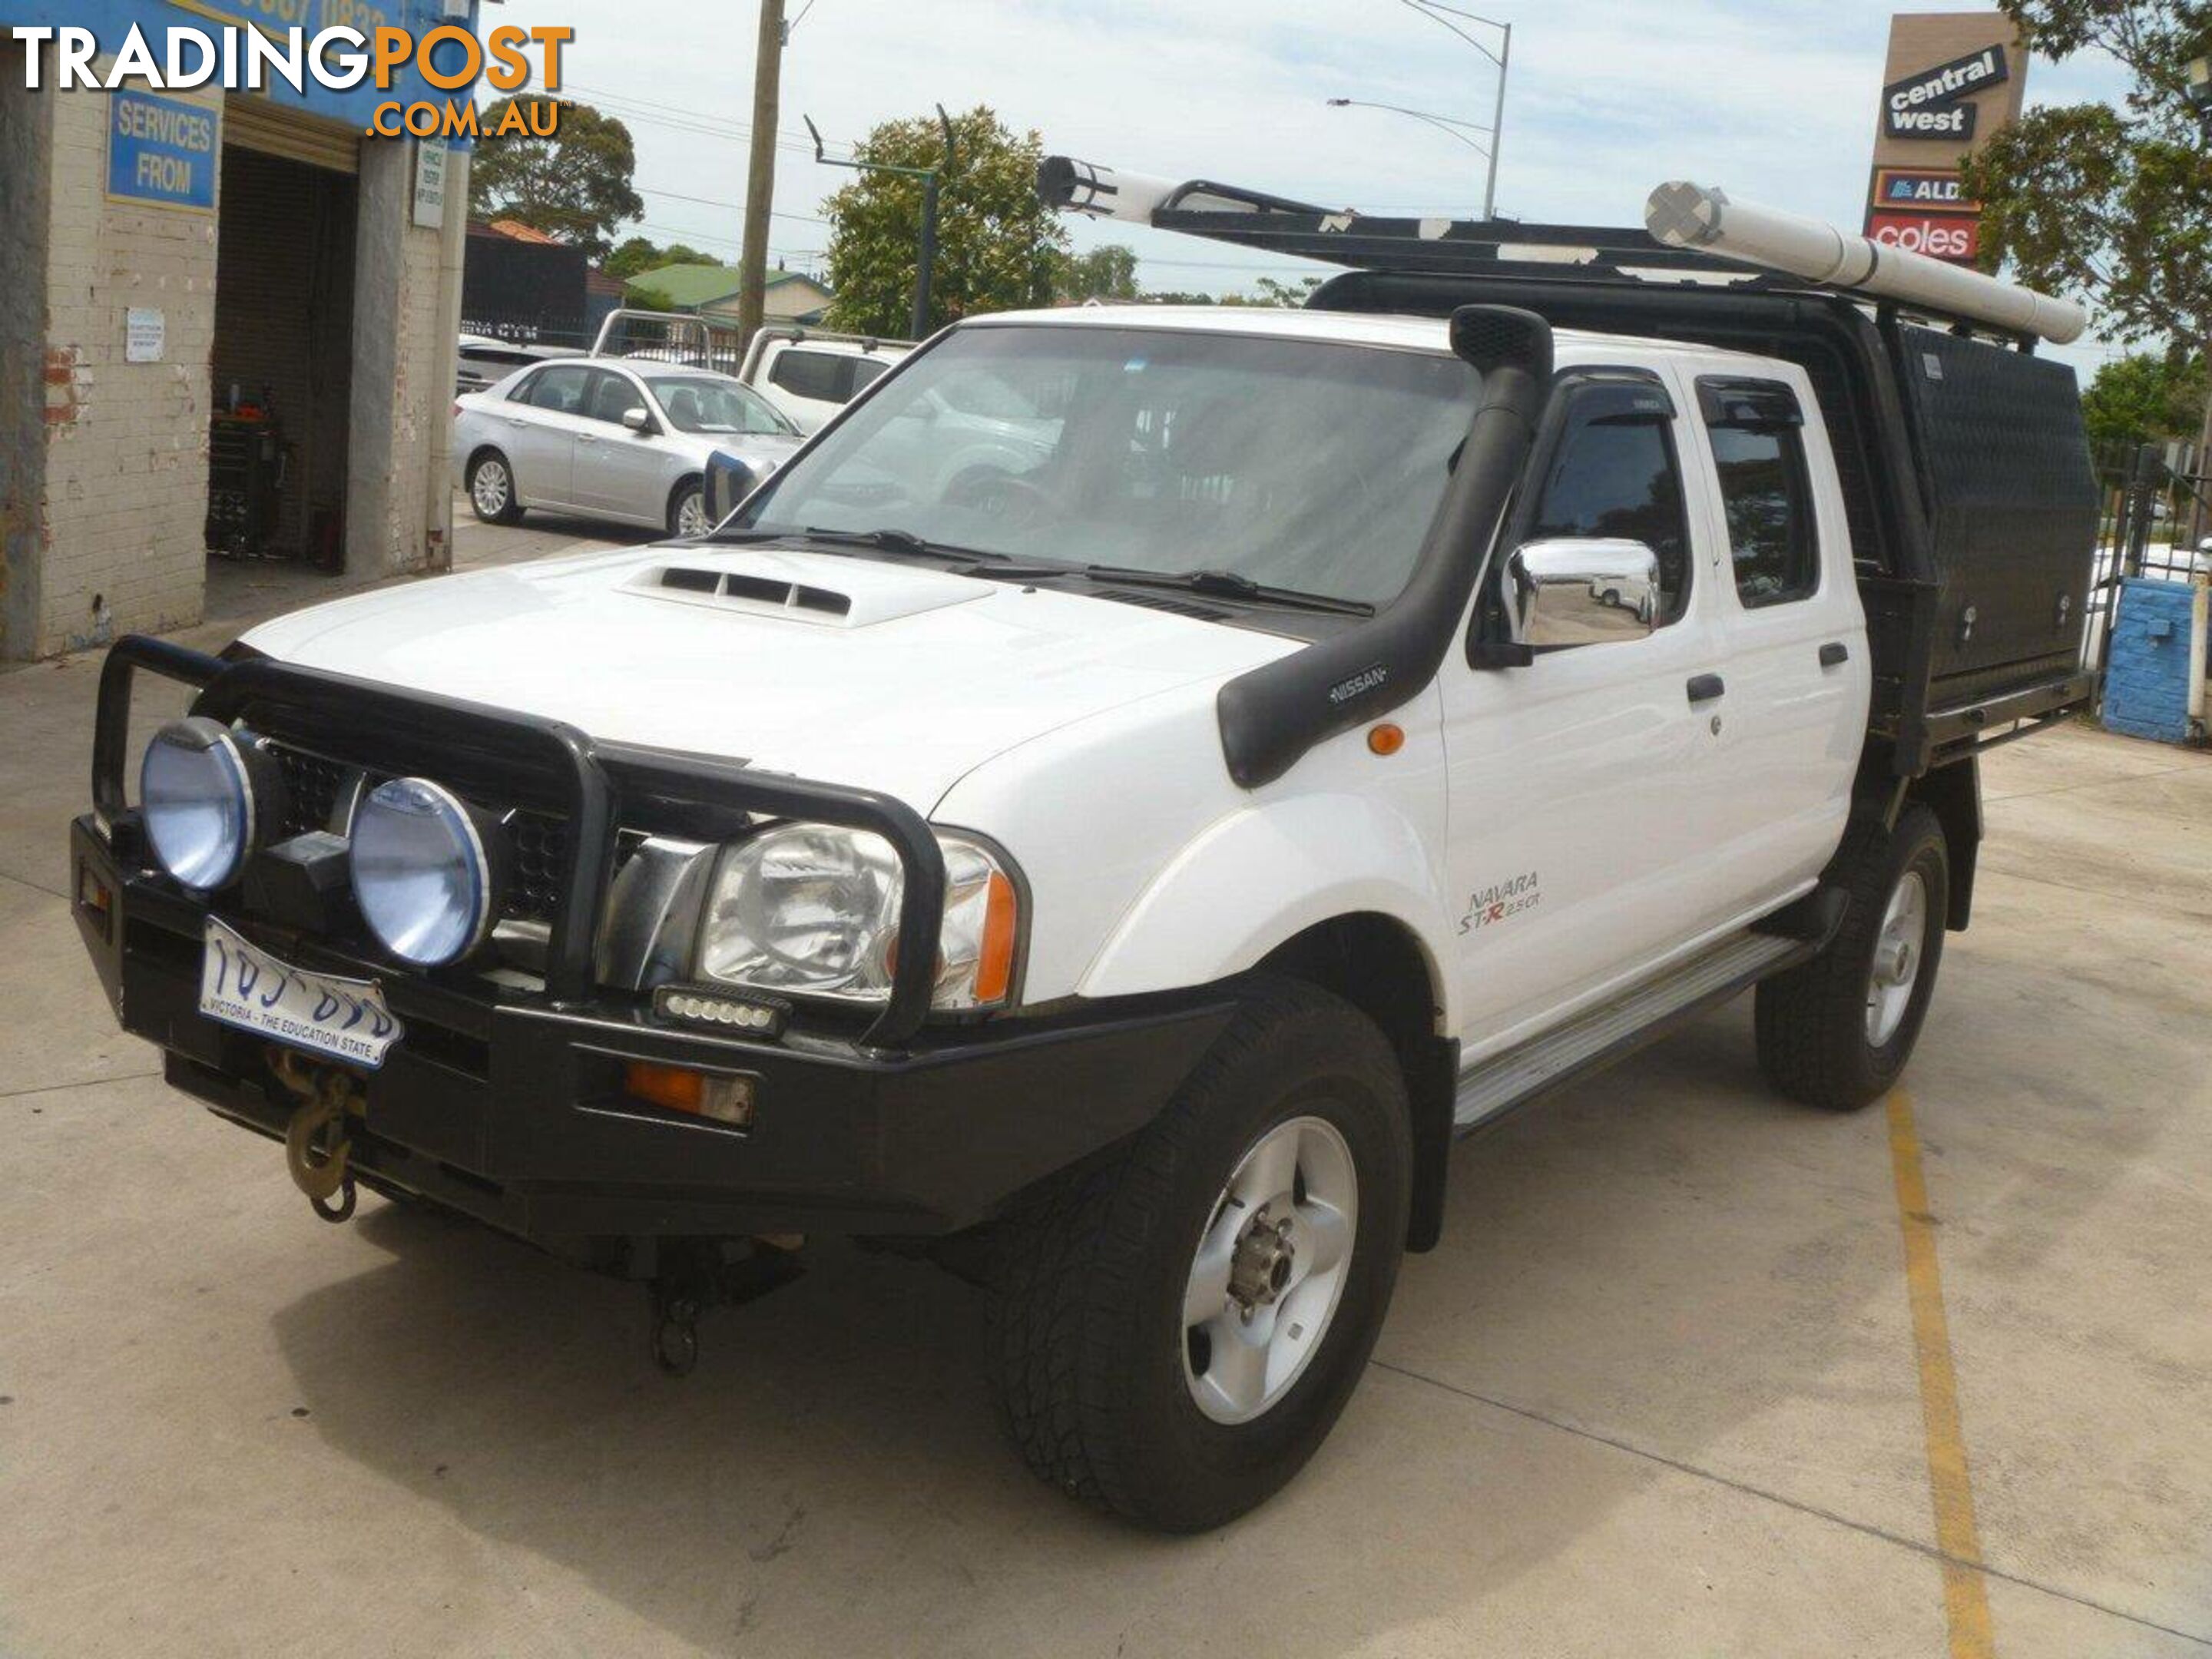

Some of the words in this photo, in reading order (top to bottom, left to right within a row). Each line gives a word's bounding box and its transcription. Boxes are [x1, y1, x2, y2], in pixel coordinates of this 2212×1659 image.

[1890, 51, 1995, 111] central
[118, 99, 211, 152] SERVICES
[1892, 108, 1966, 131] west
[137, 151, 192, 194] FROM
[1876, 220, 1969, 255] coles
[1330, 667, 1386, 703] NISSAN
[1469, 870, 1538, 912] NAVARA
[209, 998, 252, 1022] VICTORIA
[260, 1013, 279, 1031] THE
[281, 1018, 339, 1048] EDUCATION
[339, 1037, 373, 1057] STATE
